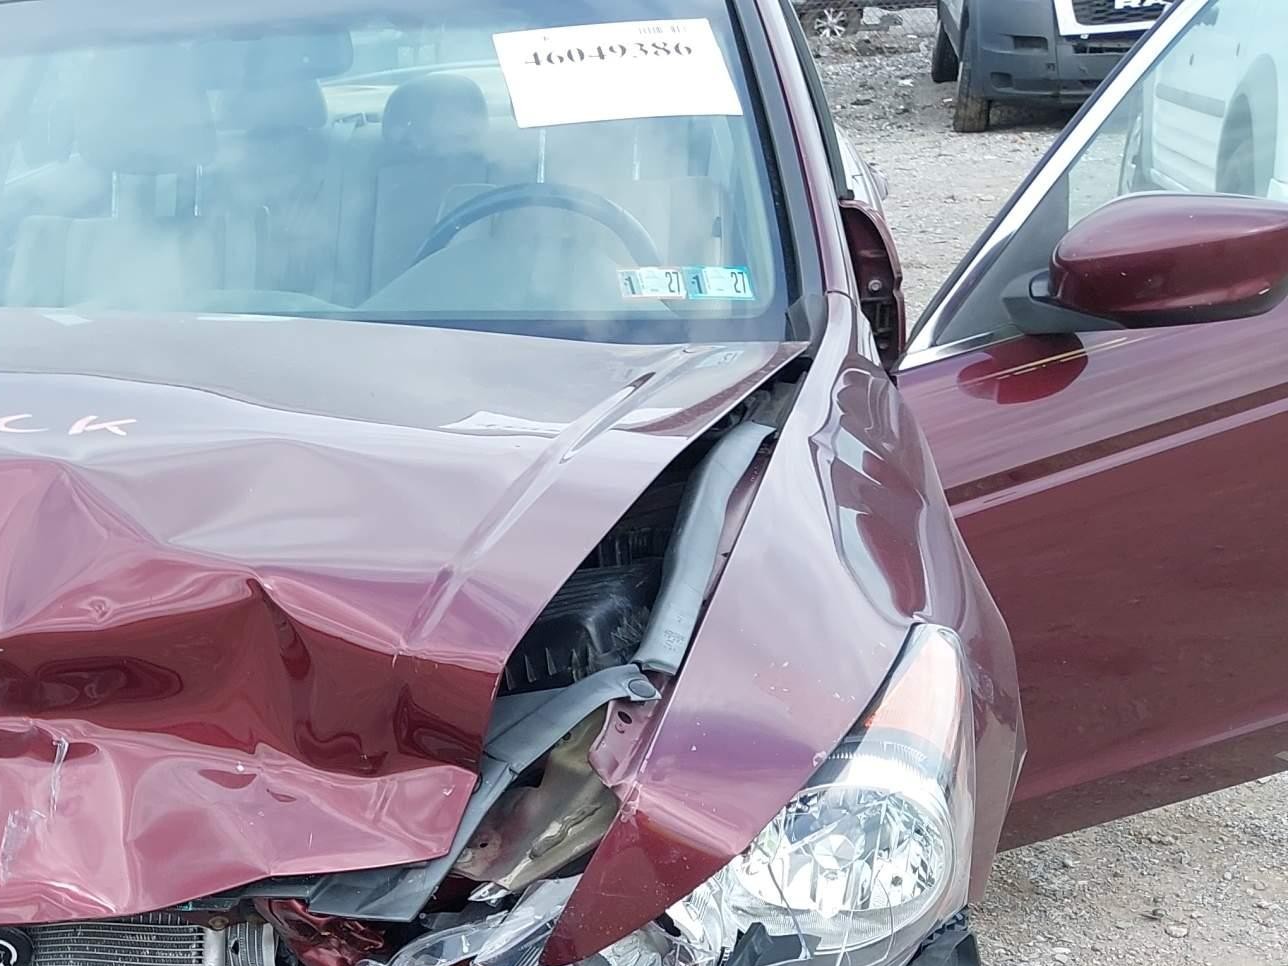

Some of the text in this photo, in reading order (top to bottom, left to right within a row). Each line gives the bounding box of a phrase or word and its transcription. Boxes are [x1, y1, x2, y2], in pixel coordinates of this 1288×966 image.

[525, 42, 693, 66] 46049386
[665, 271, 681, 294] 27
[730, 271, 747, 294] 27
